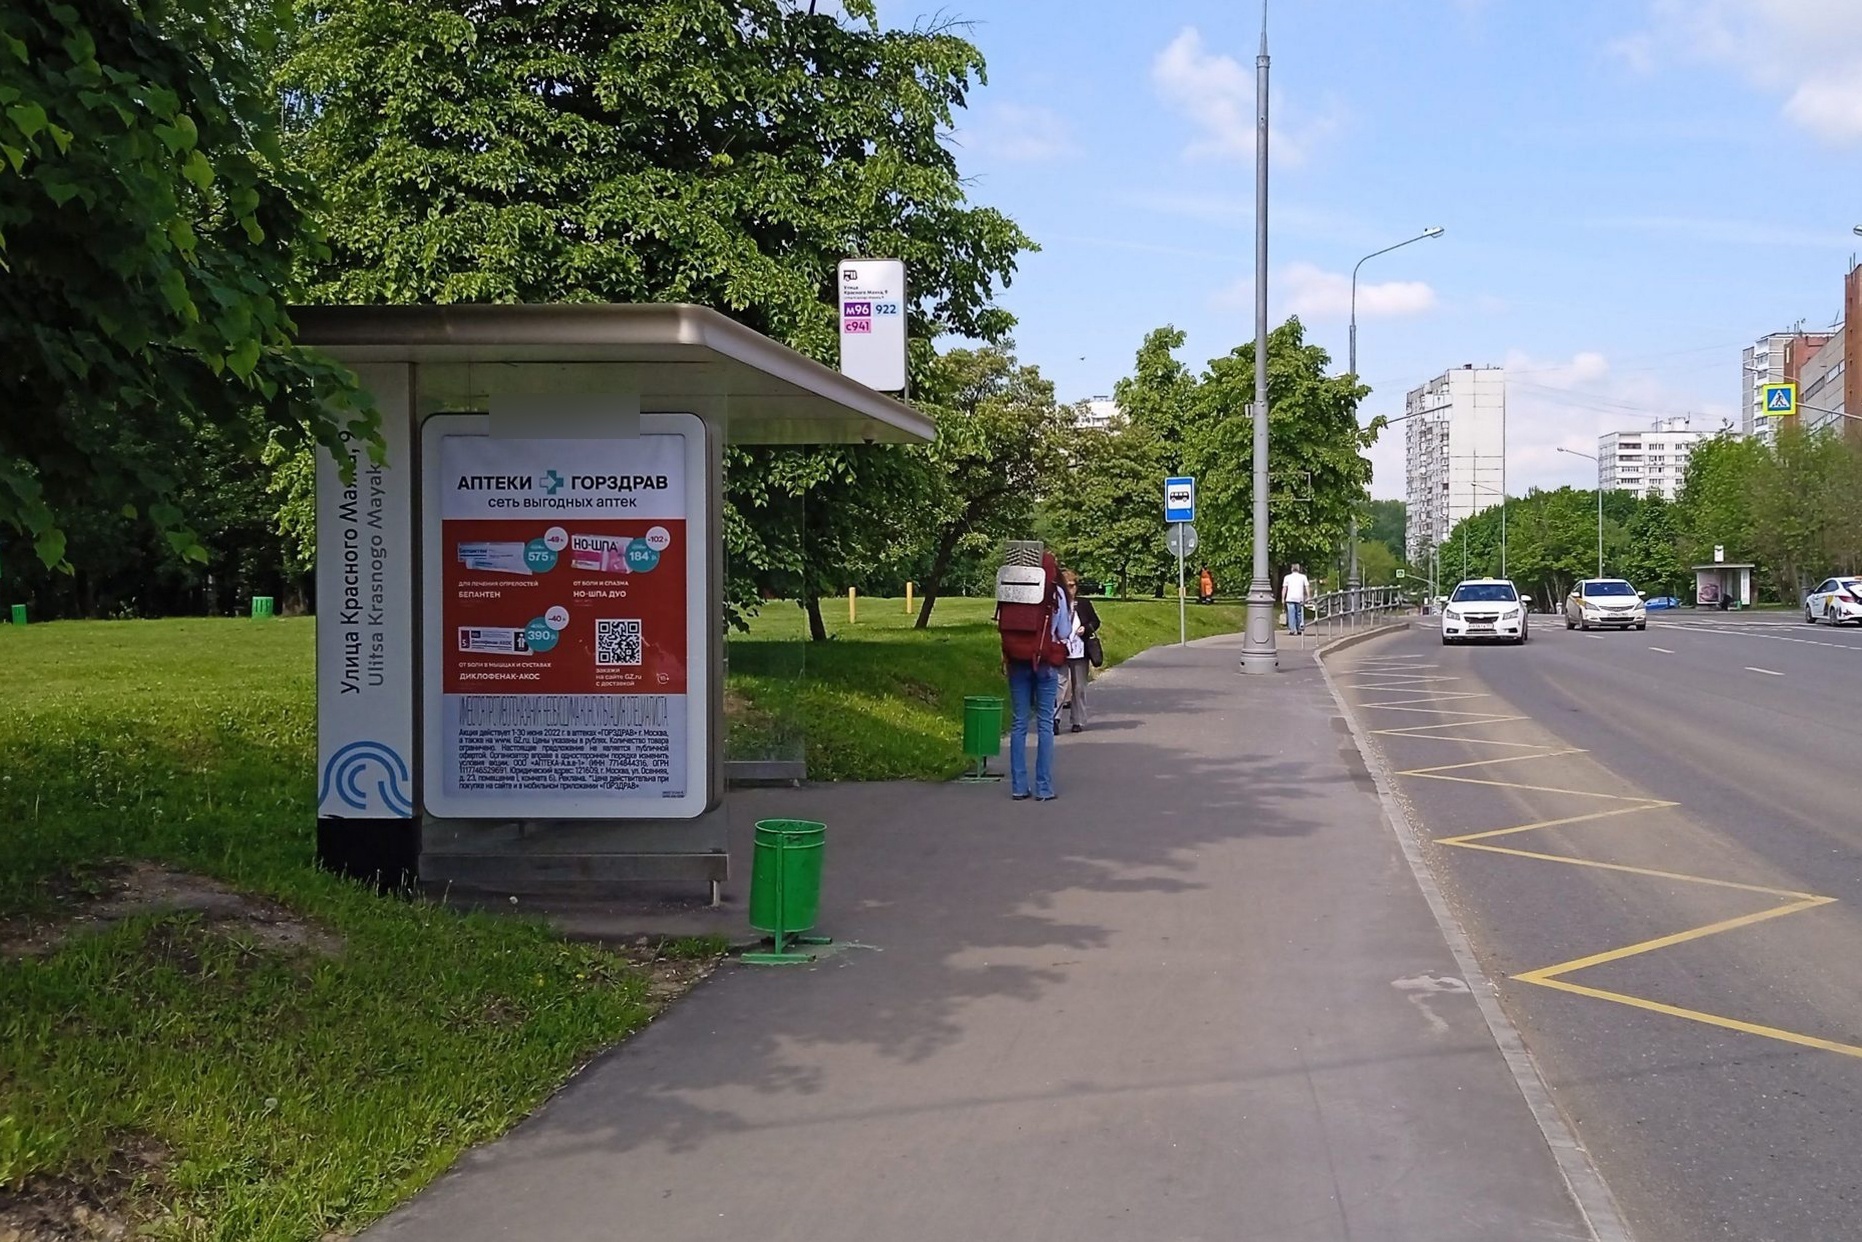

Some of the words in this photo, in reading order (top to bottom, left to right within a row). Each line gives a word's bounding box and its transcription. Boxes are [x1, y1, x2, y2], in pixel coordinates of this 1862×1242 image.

[875, 304, 897, 315] 922
[338, 430, 357, 443] 9
[457, 476, 532, 490] АПТЕКИ
[571, 475, 668, 492] ГОРЗДРАВ
[366, 458, 387, 530] Mayak
[488, 498, 520, 508] сеть
[523, 498, 594, 510] выгодных
[596, 498, 637, 508] аптек
[528, 551, 549, 561] 575
[339, 528, 364, 625] Красного
[367, 535, 387, 626] Krasnogo
[573, 590, 607, 598] НО-ШПА
[608, 590, 627, 598] ДУО
[527, 631, 550, 641] 390
[340, 631, 362, 694] Улица
[367, 632, 384, 687] Ulitsa
[459, 672, 541, 680] ДИКЛОФЕНАК-АКОС
